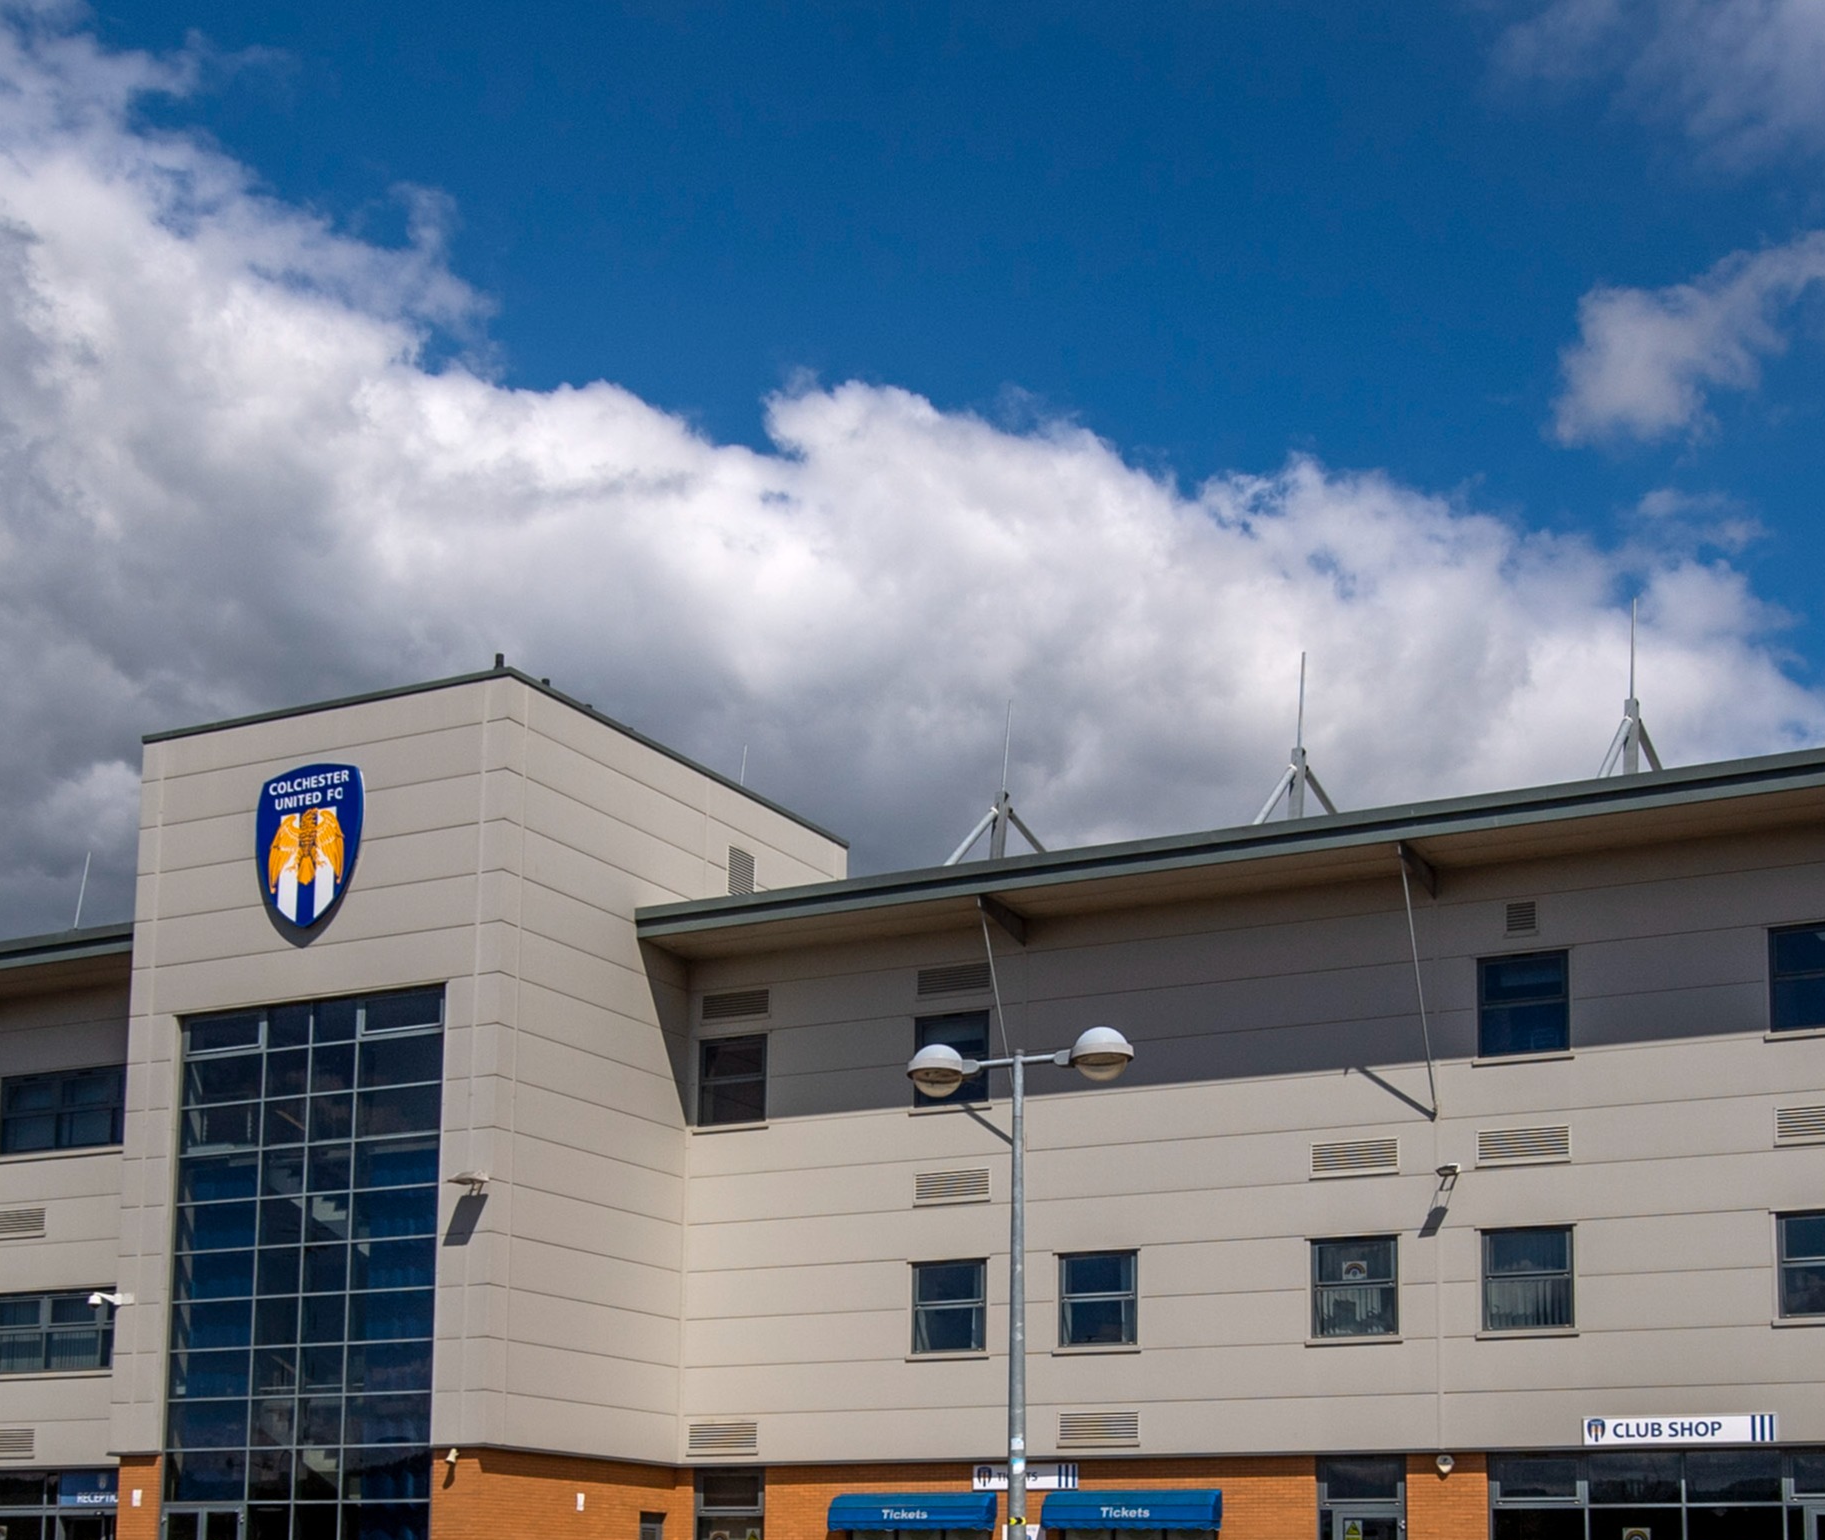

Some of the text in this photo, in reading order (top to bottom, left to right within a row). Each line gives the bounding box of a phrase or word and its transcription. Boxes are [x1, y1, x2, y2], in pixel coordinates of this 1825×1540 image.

[268, 769, 349, 796] COLCHESTER
[274, 786, 343, 811] UNITED FC
[1612, 1421, 1722, 1438] CLUB SHOP
[996, 1471, 1038, 1482] TITS
[77, 1492, 119, 1503] RECEPTI
[881, 1508, 928, 1520] Tickets
[1100, 1507, 1150, 1518] Tickets
